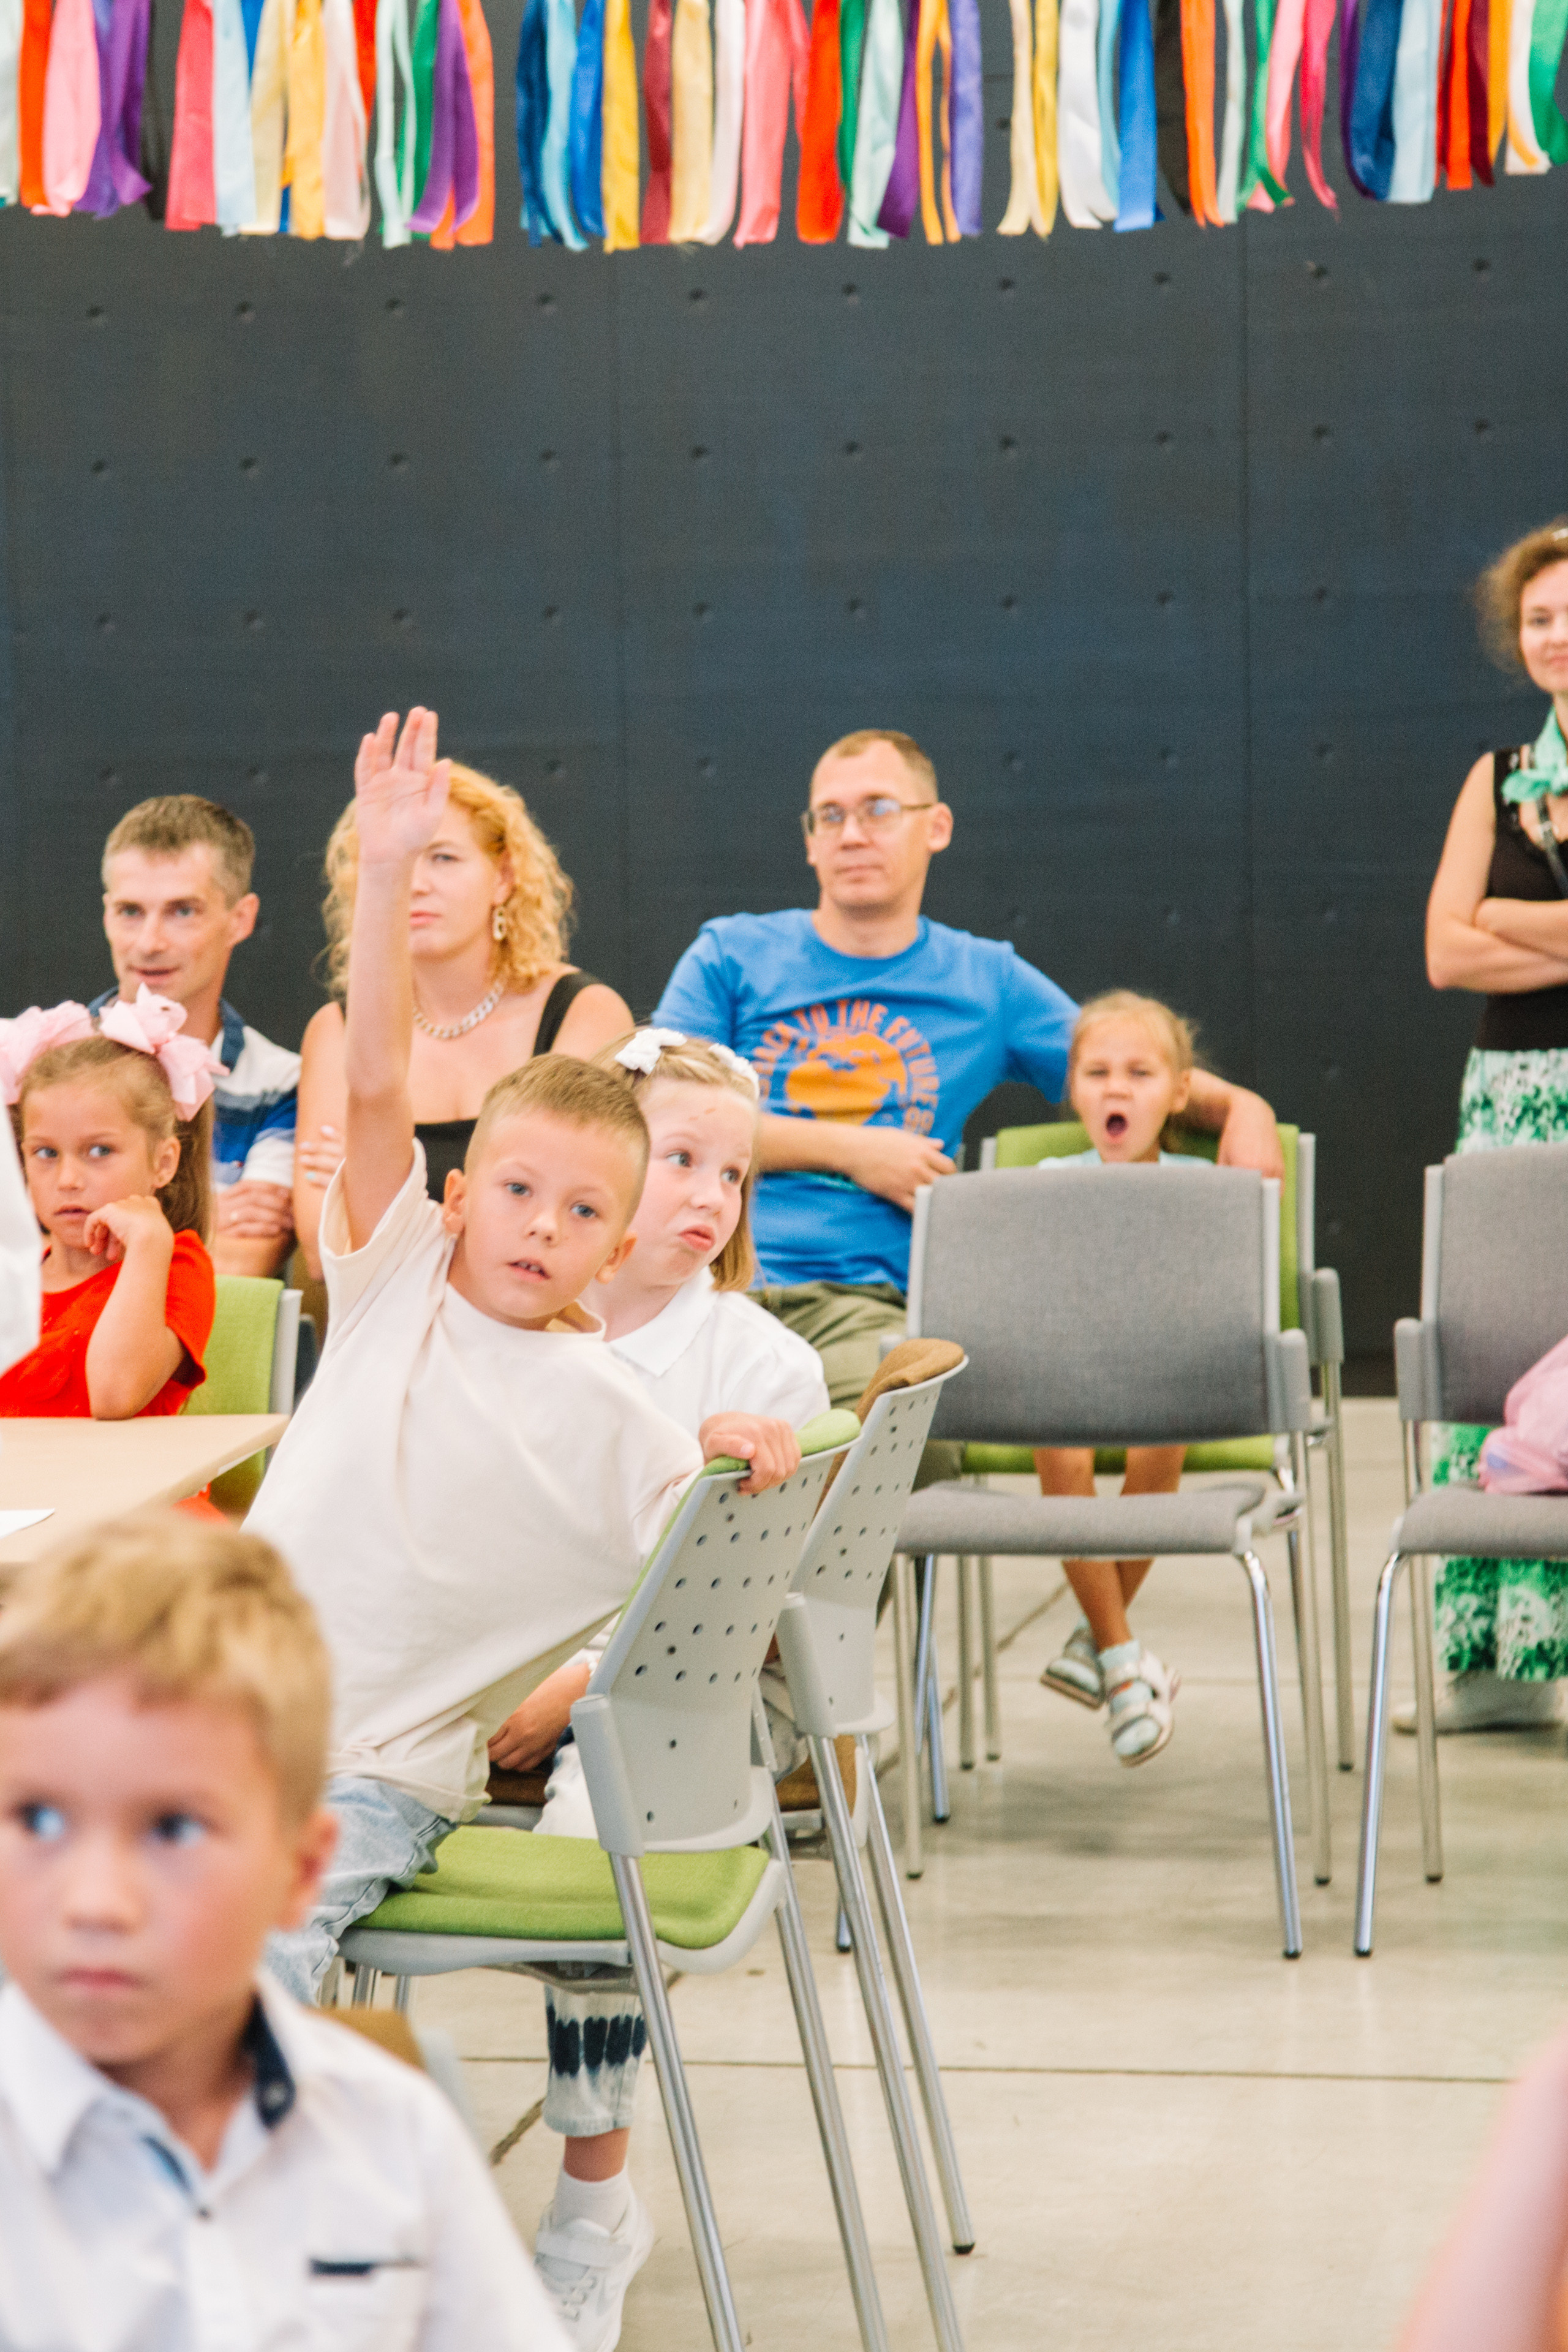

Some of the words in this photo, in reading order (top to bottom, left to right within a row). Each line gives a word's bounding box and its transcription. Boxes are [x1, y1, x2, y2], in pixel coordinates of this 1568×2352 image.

[792, 1003, 830, 1035] TO
[835, 999, 889, 1033] THE
[884, 1016, 940, 1110] FUTURE
